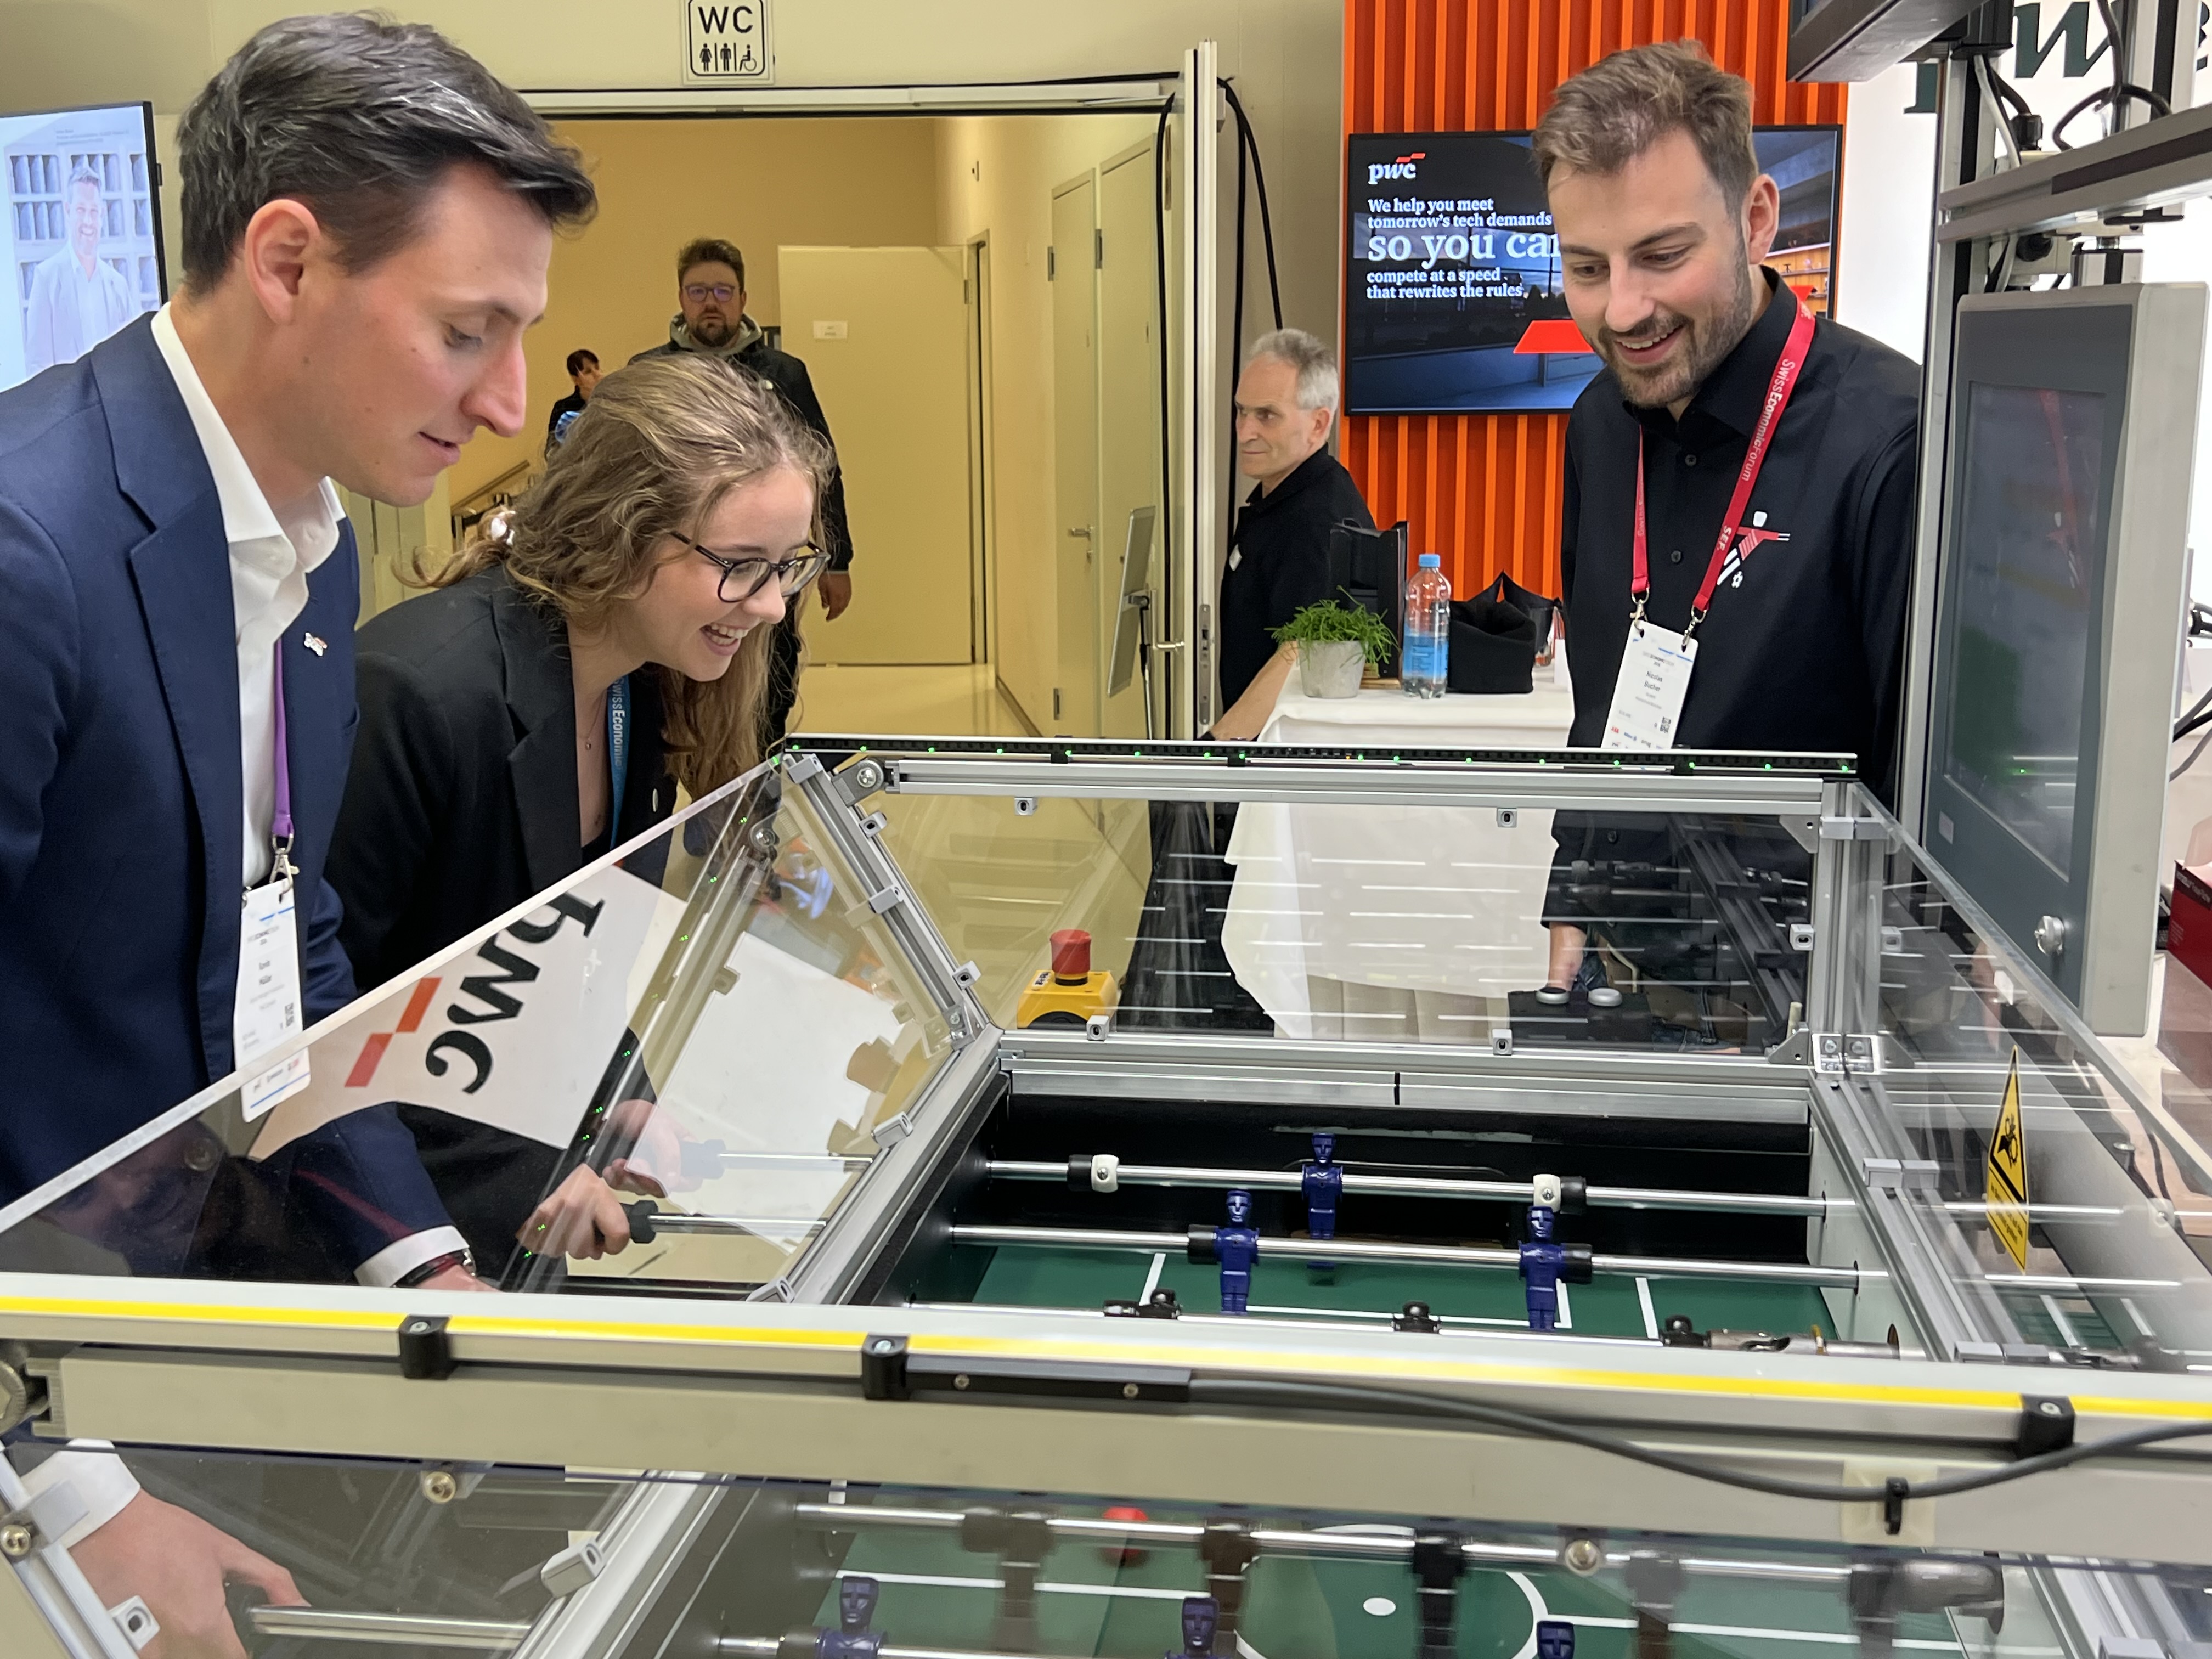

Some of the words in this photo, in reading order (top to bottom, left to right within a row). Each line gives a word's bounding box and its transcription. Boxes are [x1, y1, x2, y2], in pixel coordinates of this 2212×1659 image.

[697, 5, 753, 34] WC
[1368, 163, 1417, 184] pwc
[1368, 199, 1391, 212] We
[1393, 197, 1425, 215] help
[1427, 200, 1454, 215] you
[1457, 198, 1494, 211] meet
[1368, 213, 1451, 228] tomorrow's
[1453, 212, 1483, 227] tech
[1486, 211, 1552, 227] demands
[1368, 234, 1412, 261] so
[1421, 234, 1496, 269] you
[1367, 270, 1427, 286] compete
[1430, 269, 1445, 282] at
[1447, 271, 1457, 282] a
[1459, 267, 1501, 286] speed
[1367, 285, 1396, 299] that
[1398, 284, 1457, 299] rewrites
[1460, 283, 1484, 297] the
